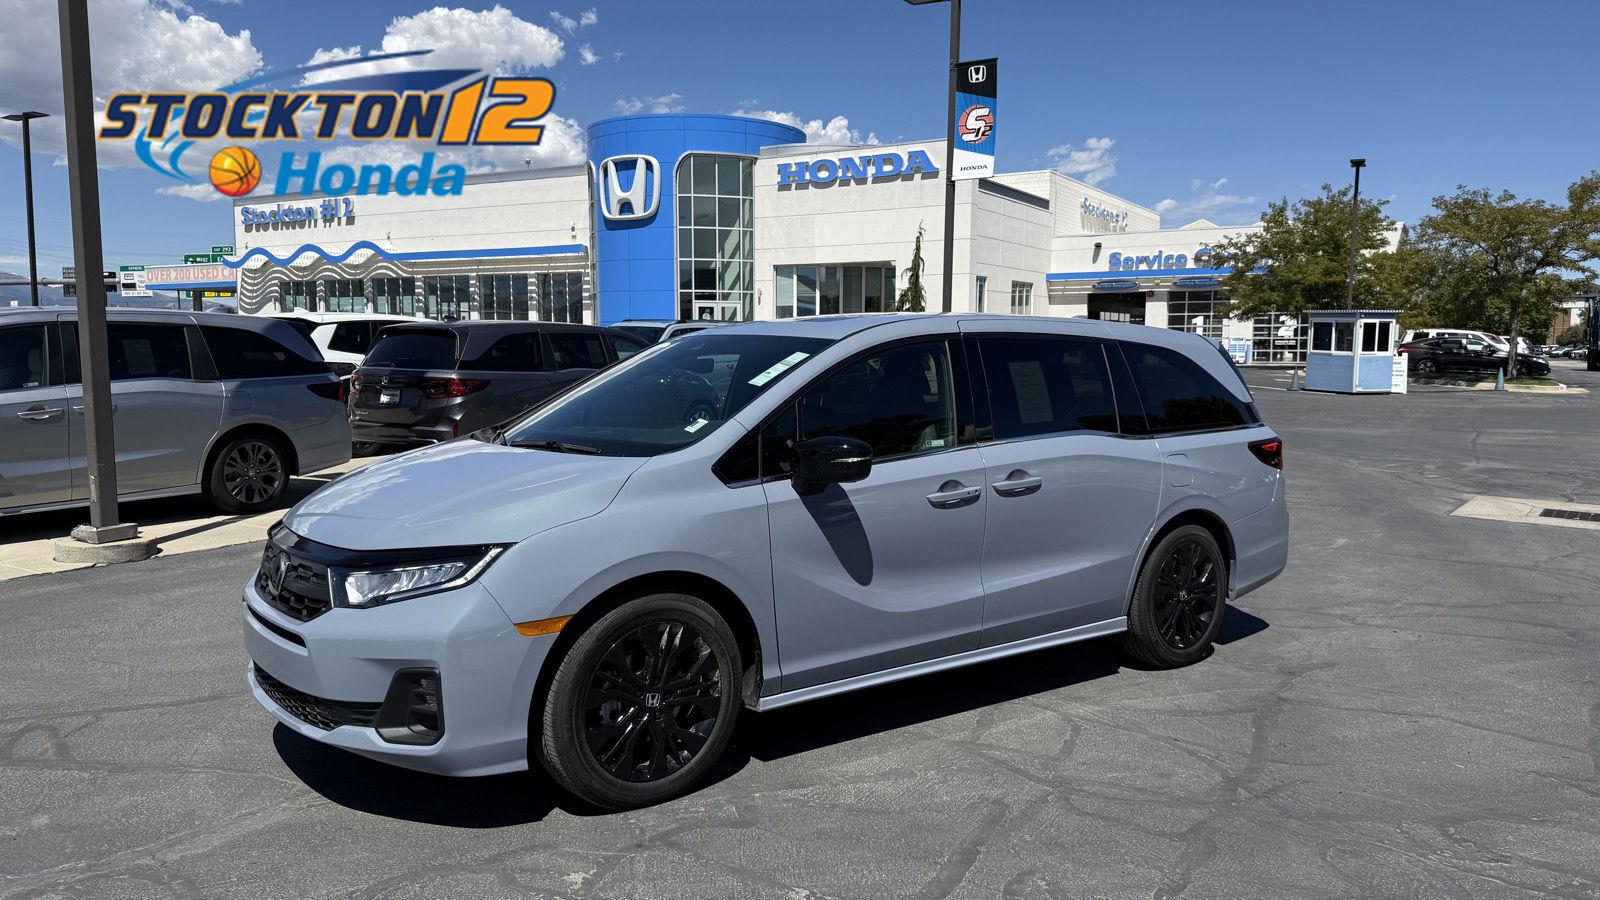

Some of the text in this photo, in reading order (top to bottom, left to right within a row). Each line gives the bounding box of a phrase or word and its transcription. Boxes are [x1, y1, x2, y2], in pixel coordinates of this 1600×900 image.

[777, 149, 940, 186] HONDA
[960, 164, 988, 172] HONDA
[241, 197, 355, 225] Stockton #12
[1109, 250, 1188, 269] Service
[147, 268, 172, 282] OVER
[174, 268, 191, 281] 200
[193, 267, 218, 280] USED
